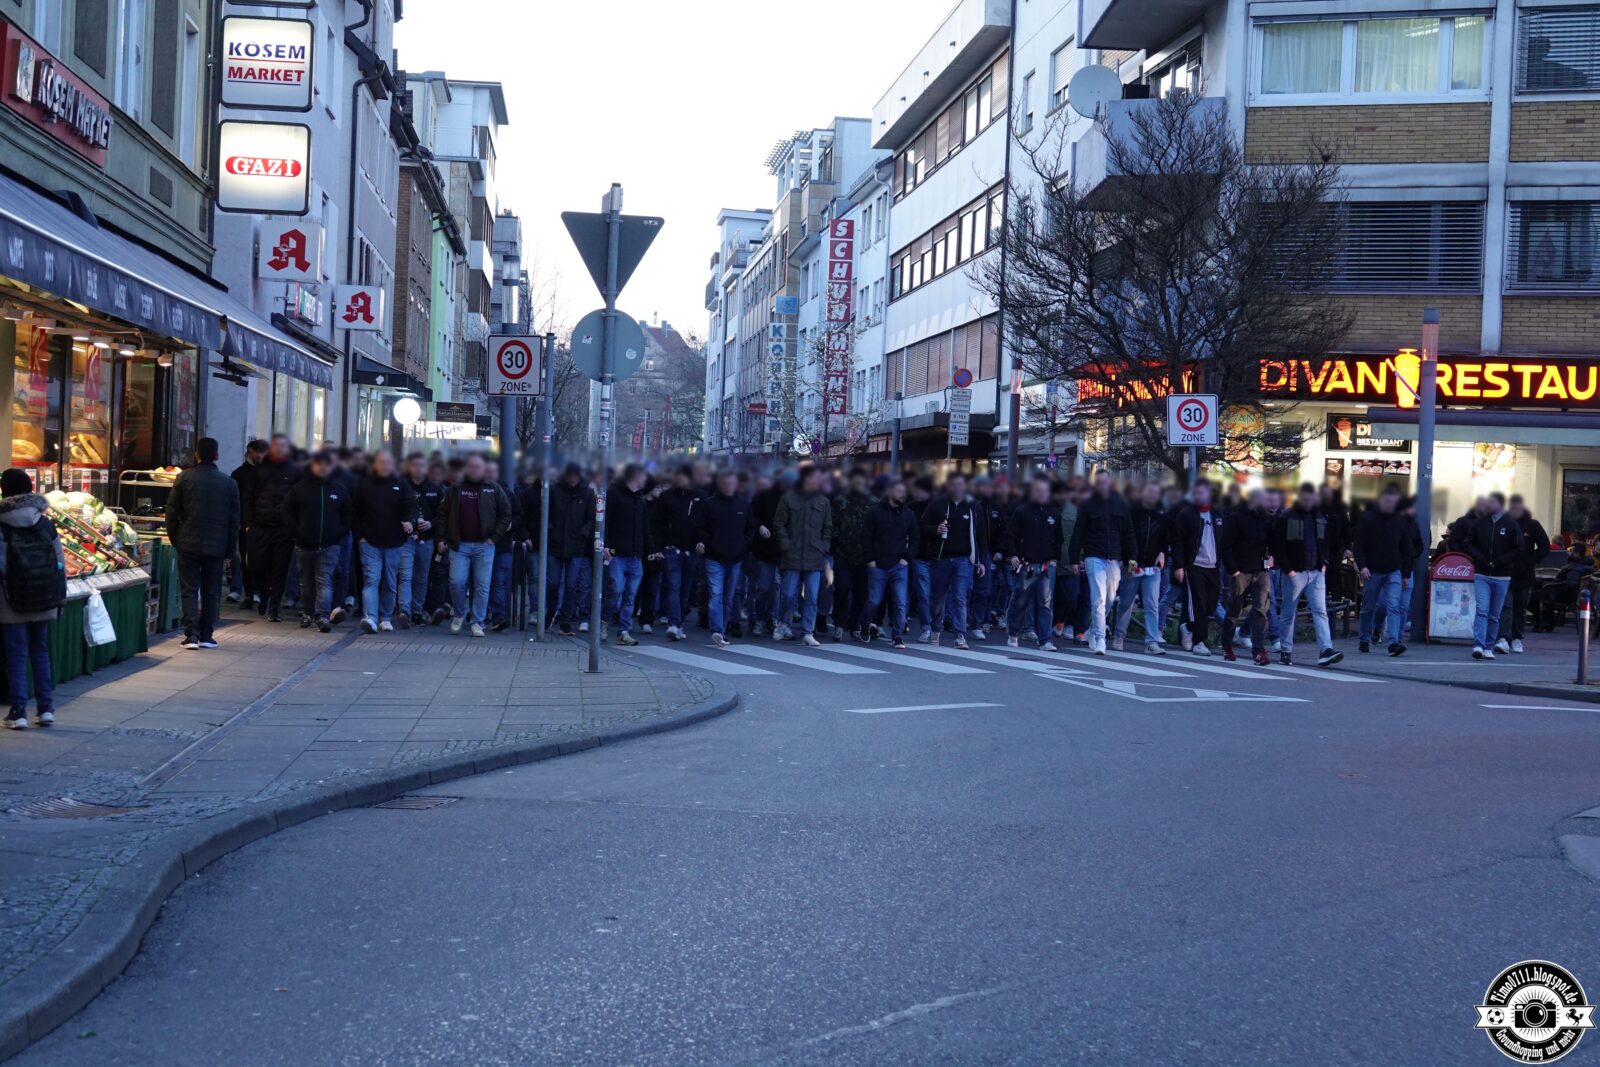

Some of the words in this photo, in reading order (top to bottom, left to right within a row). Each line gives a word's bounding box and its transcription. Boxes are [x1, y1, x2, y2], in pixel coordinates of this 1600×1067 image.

[227, 66, 305, 82] MARKET
[504, 350, 525, 368] 30
[1260, 359, 1387, 394] DIVAN
[500, 381, 527, 392] ZONE
[1183, 407, 1203, 423] 30
[1181, 433, 1206, 442] ZONE
[1356, 438, 1404, 447] RESTAURANT
